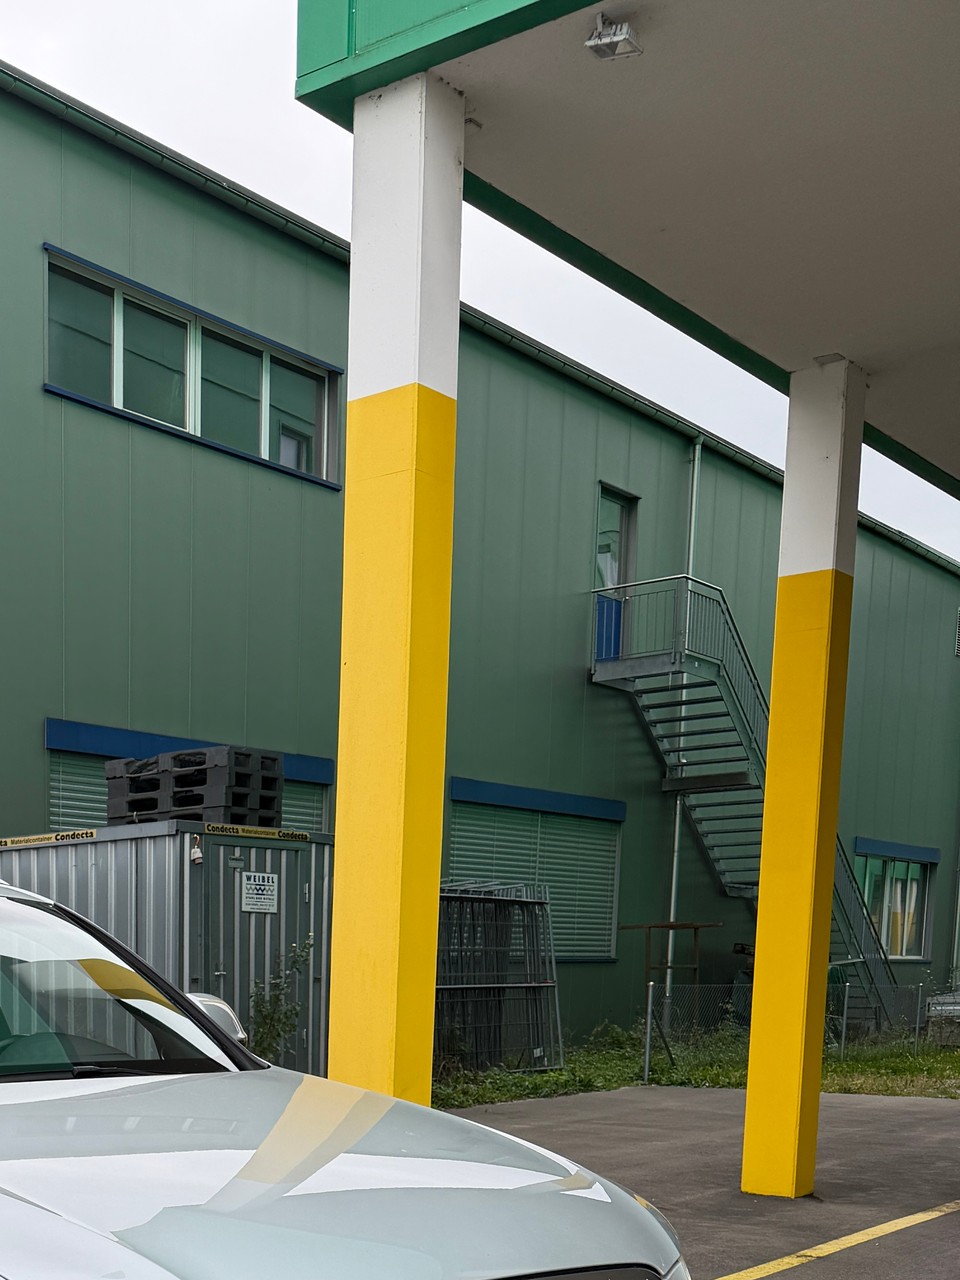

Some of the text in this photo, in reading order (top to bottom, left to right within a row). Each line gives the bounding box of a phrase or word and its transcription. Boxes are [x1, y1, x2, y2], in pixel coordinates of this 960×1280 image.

[10, 836, 53, 845] Materialcontainer
[55, 831, 94, 842] Condecta
[207, 824, 239, 834] Condecta
[278, 830, 308, 840] Condecta
[245, 874, 275, 884] WEIBEL
